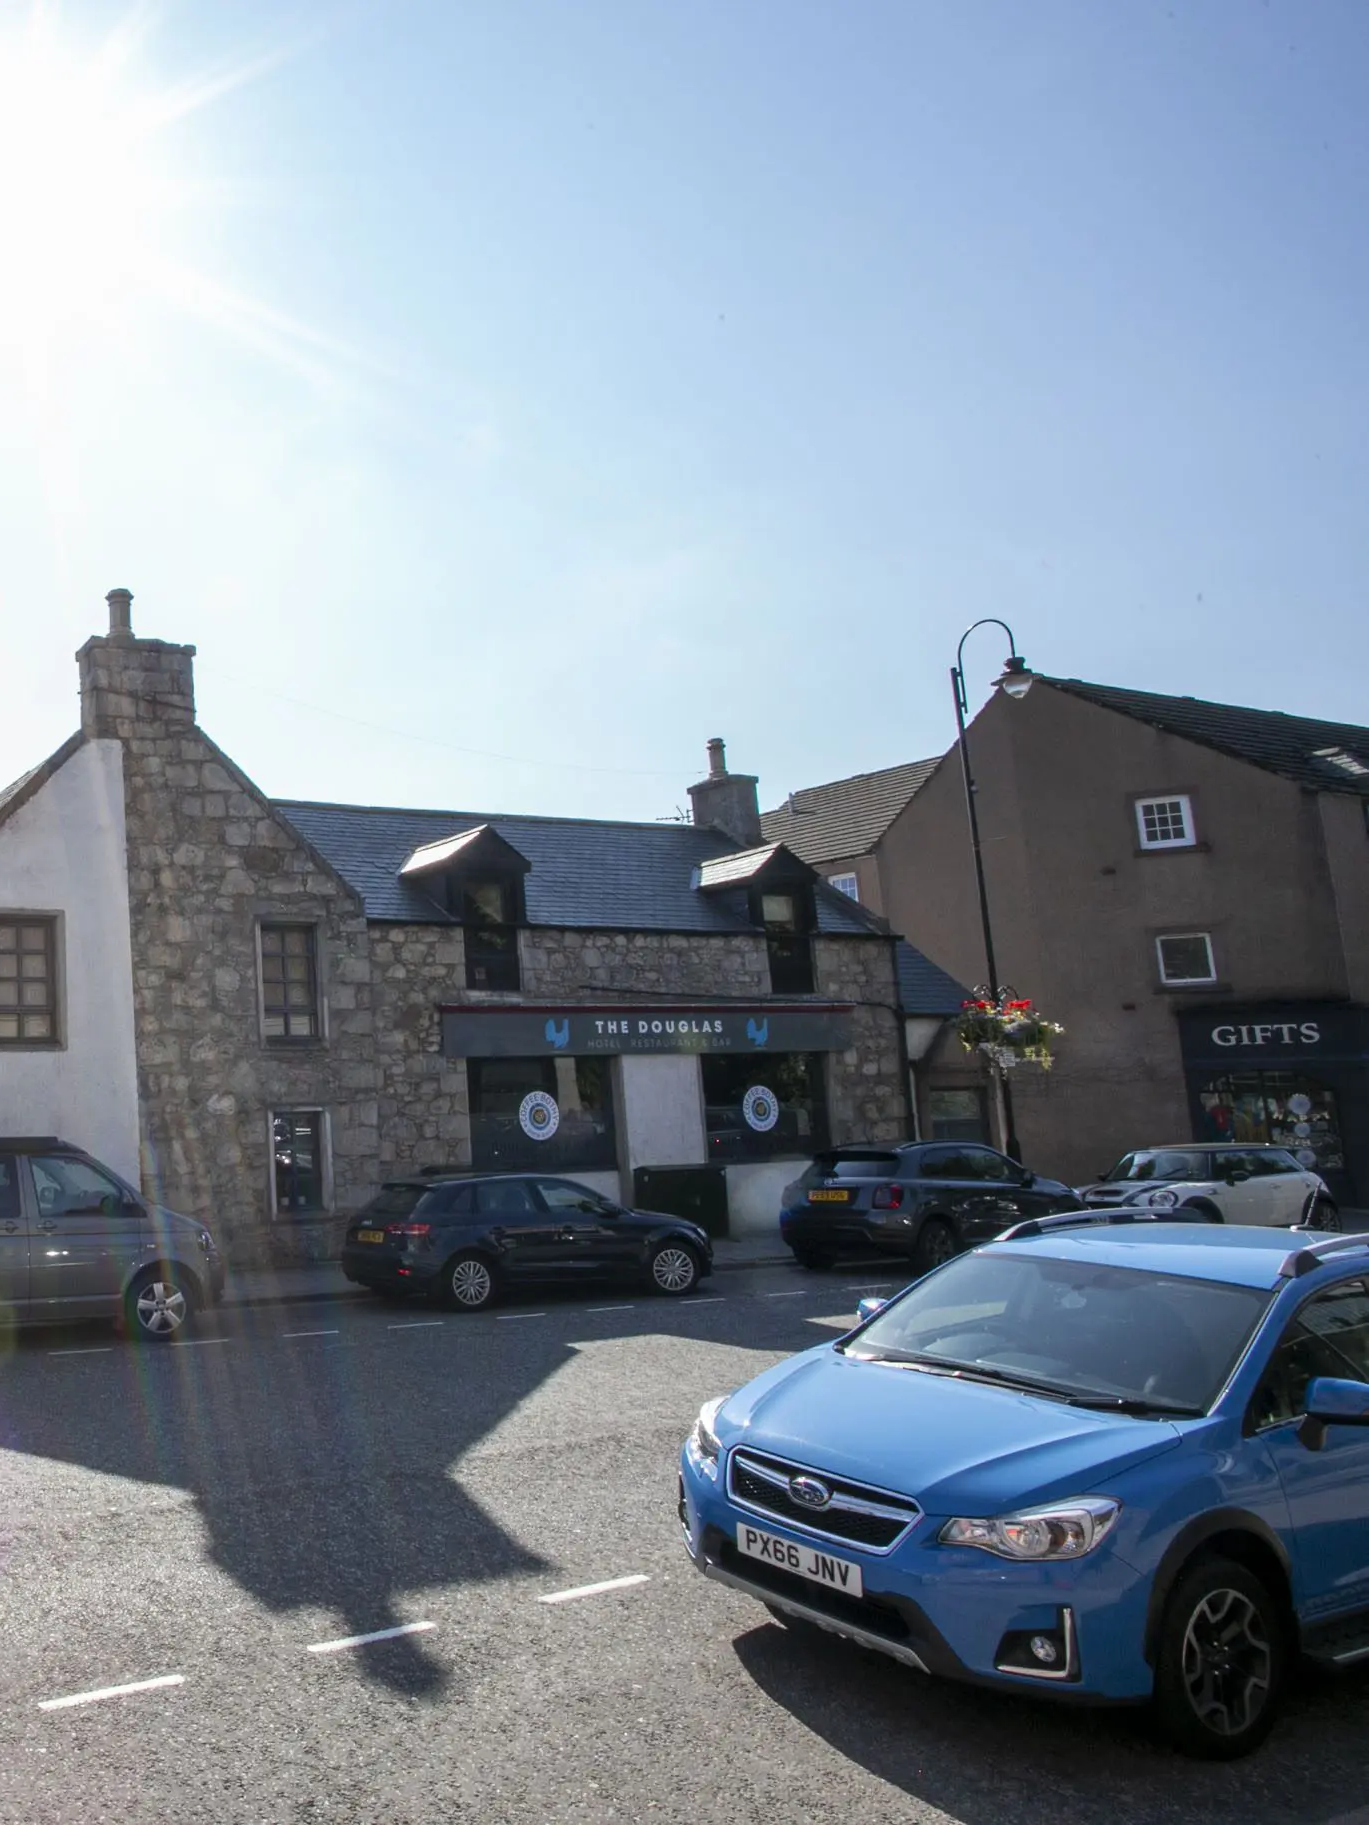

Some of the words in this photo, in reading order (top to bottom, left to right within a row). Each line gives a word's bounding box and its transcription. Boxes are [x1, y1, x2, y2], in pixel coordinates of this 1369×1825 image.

[595, 1020, 629, 1034] THE
[638, 1020, 723, 1034] DOUGLAS
[1211, 1022, 1320, 1046] GIFTS
[631, 1038, 698, 1048] RESTAURANT
[711, 1037, 731, 1047] BAR
[520, 1093, 540, 1122] COFFEE
[540, 1094, 558, 1121] BOTHY
[745, 1529, 800, 1568] PX66
[807, 1553, 849, 1586] JNV
